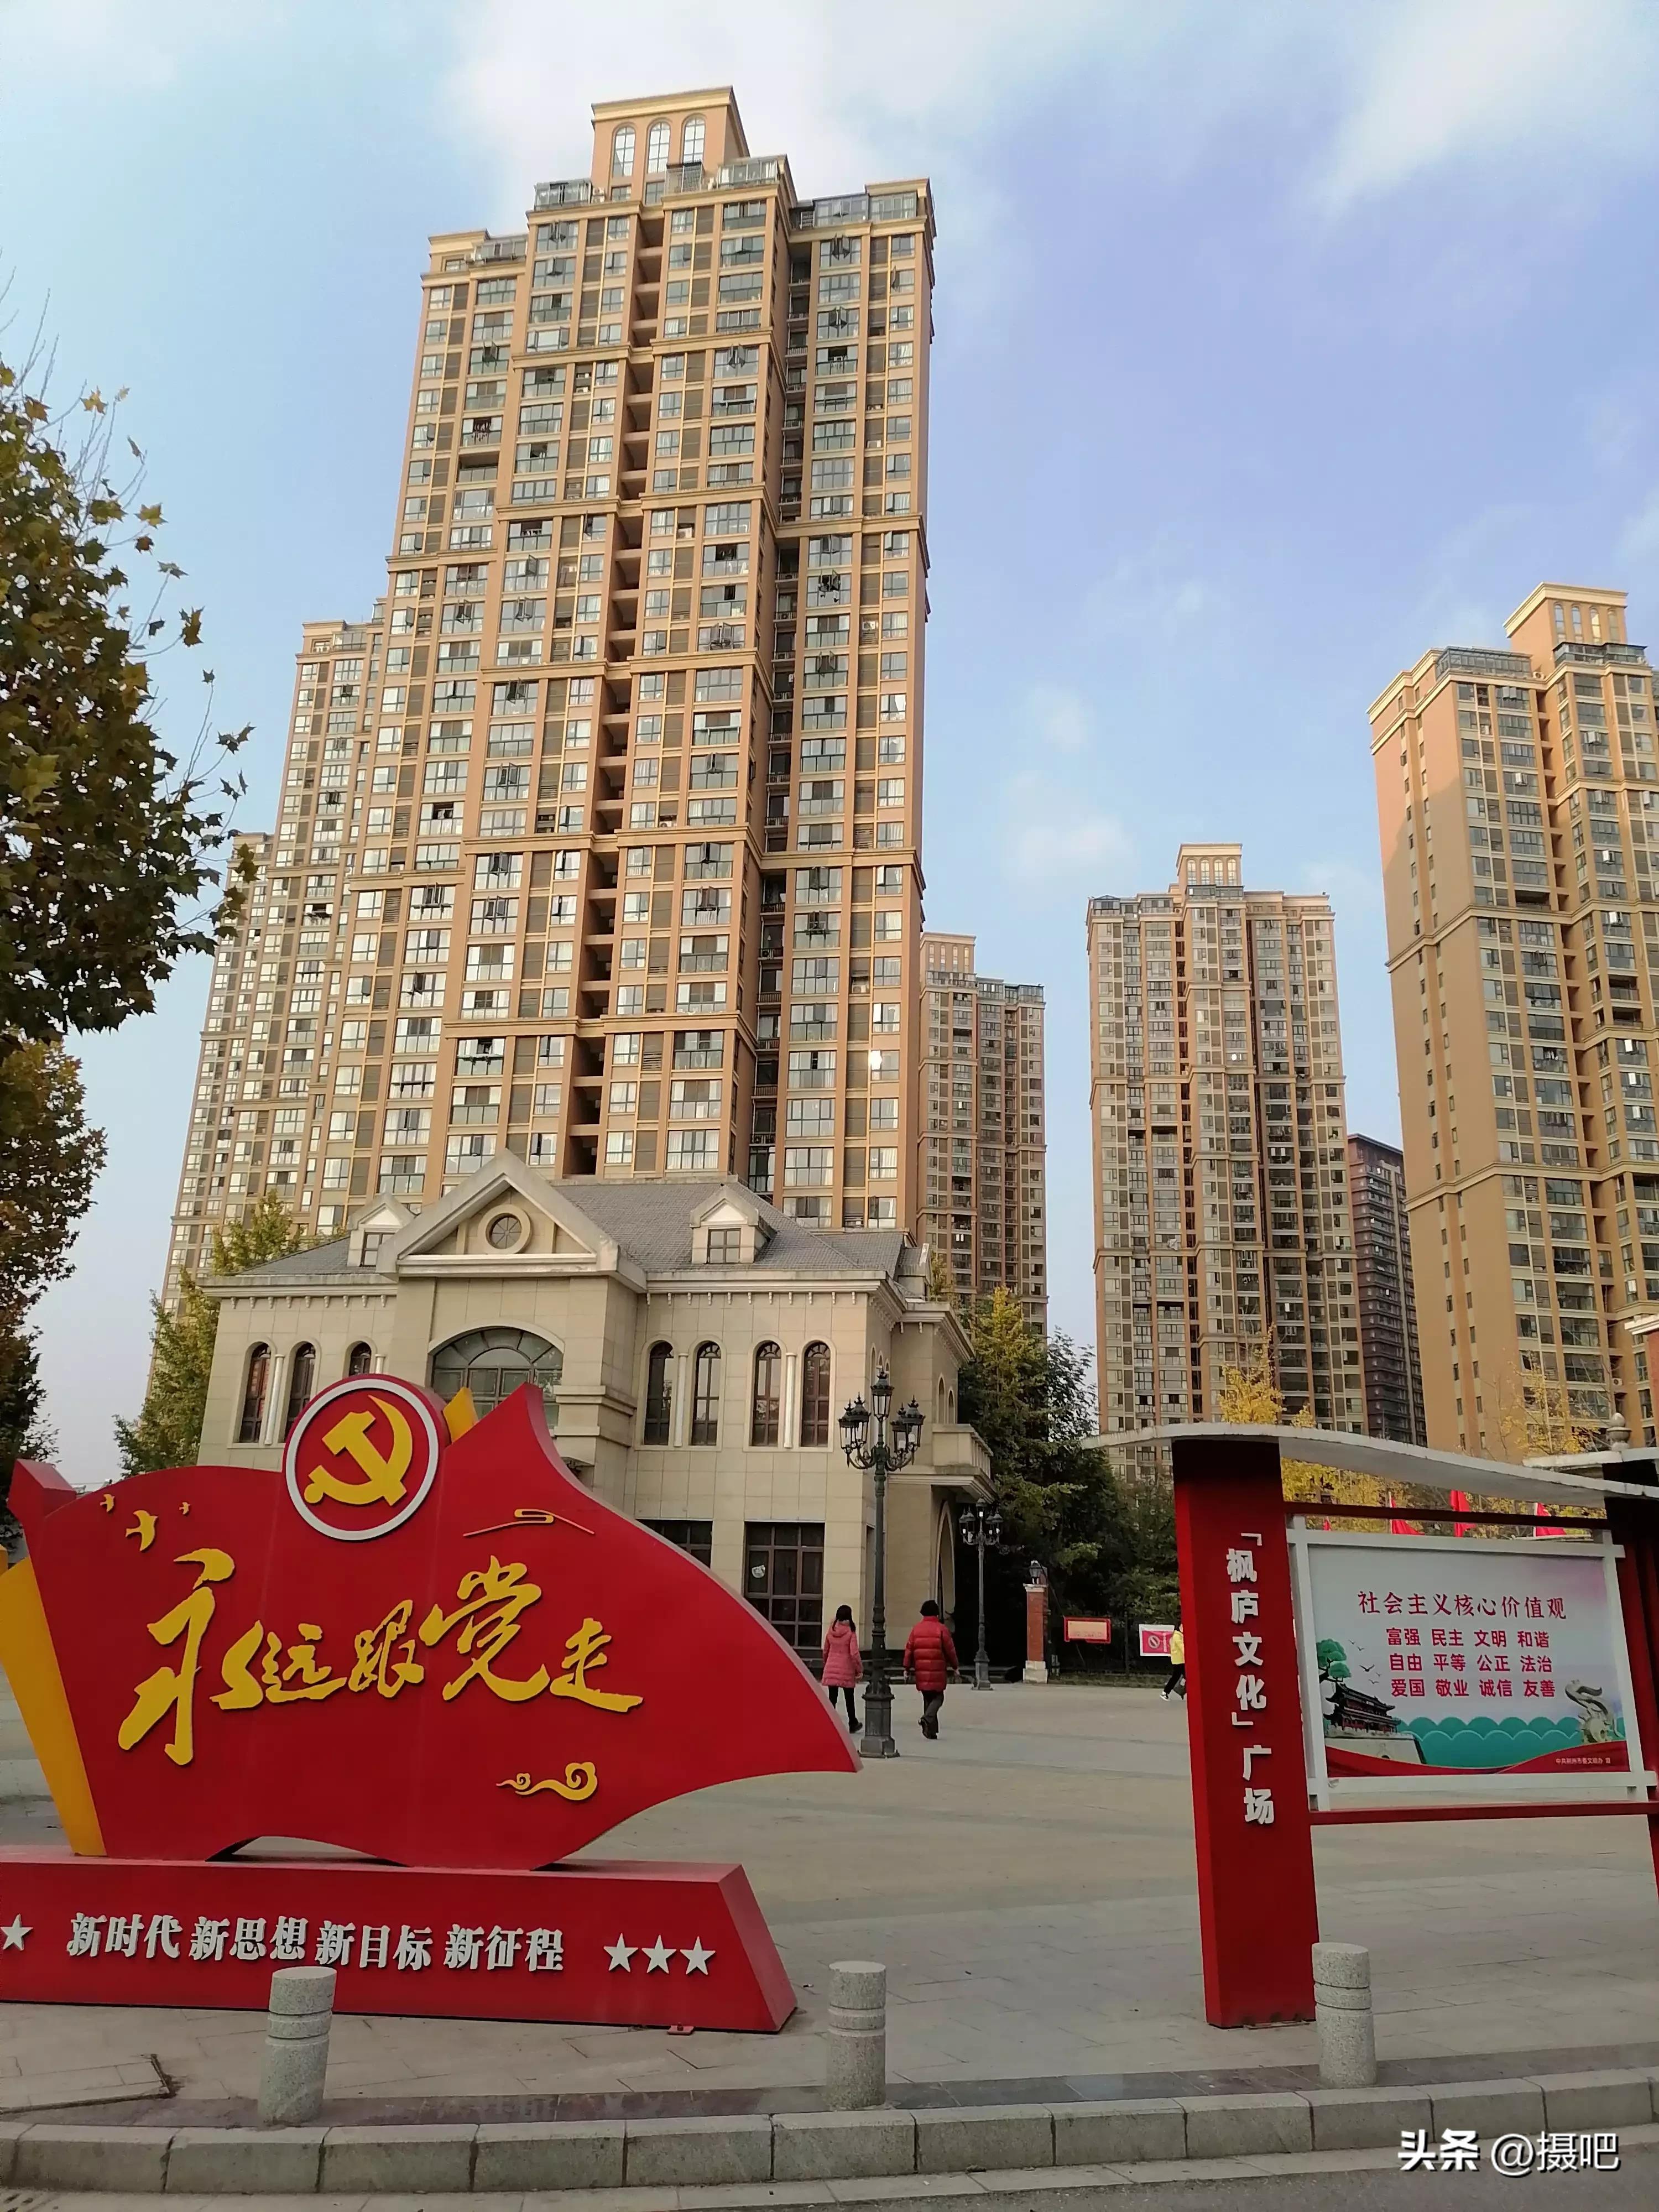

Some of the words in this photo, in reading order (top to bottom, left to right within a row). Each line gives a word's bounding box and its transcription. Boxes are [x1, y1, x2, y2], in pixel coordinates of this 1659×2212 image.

[1358, 1590, 1567, 1620] 社会主义核心价值观
[1386, 1627, 1421, 1646] 富强
[1431, 1629, 1464, 1647] 民主
[1474, 1629, 1507, 1647] 文明
[1517, 1630, 1550, 1648] 和谐
[118, 1548, 643, 1766] 永远跟党走
[1389, 1653, 1422, 1671] 自由
[1433, 1653, 1466, 1672] 平等
[1477, 1655, 1510, 1673] 公正
[1520, 1655, 1553, 1673] 法治
[1391, 1679, 1426, 1697] 爱国
[1435, 1679, 1469, 1697] 敬业
[1479, 1679, 1513, 1697] 诚信
[1523, 1679, 1556, 1698] 友善
[66, 1912, 182, 1958] 新时代
[188, 1916, 307, 1963] 新思想
[315, 1920, 434, 1971] 新目标
[443, 1924, 565, 1972] 新征程
